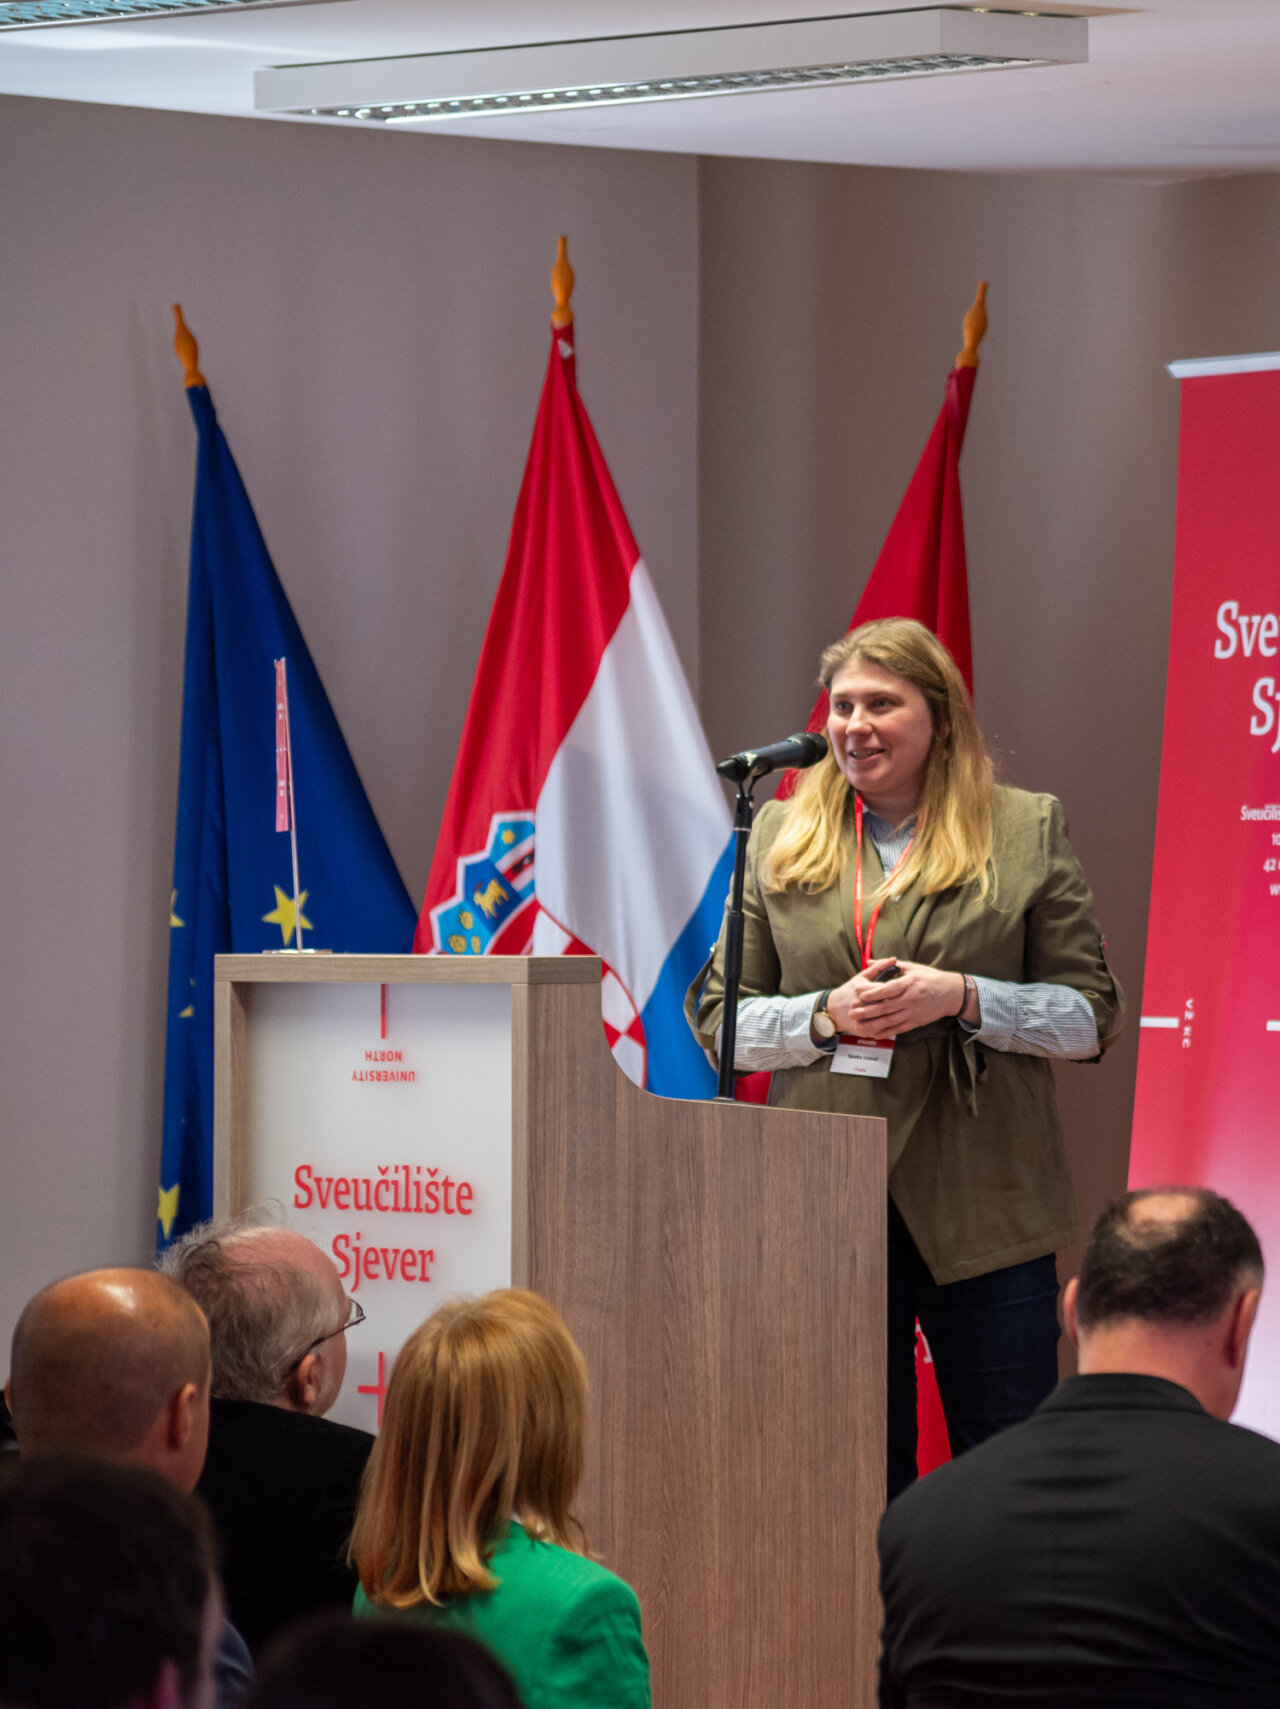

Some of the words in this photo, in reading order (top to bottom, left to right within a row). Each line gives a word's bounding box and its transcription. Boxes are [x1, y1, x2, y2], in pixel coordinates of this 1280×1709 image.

[1263, 859, 1275, 872] 42
[364, 1050, 402, 1061] NORTH
[351, 1069, 415, 1081] UNIVERSITY
[293, 1164, 473, 1216] Sveučilište
[331, 1232, 435, 1293] Sjever
